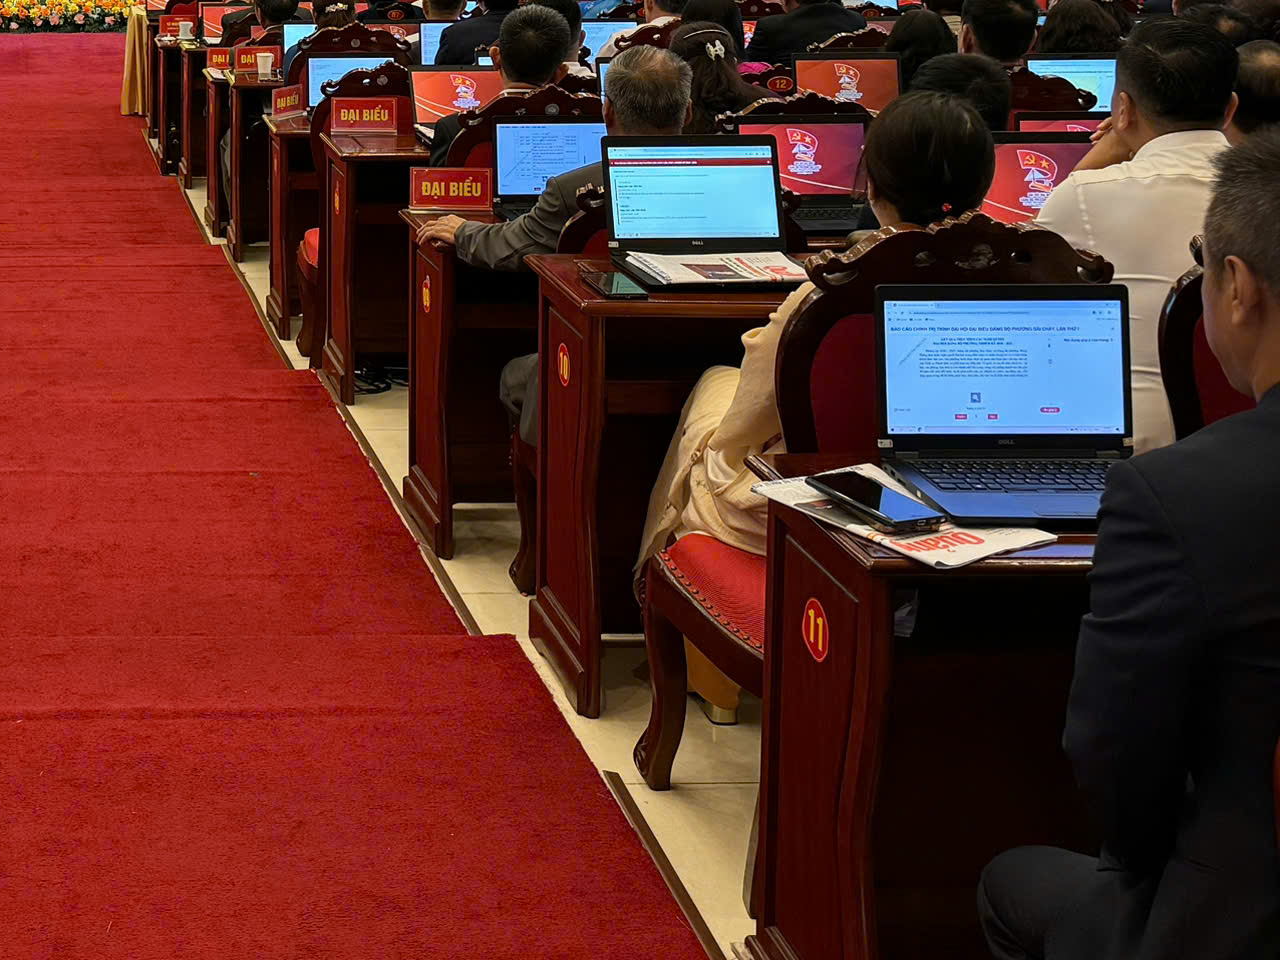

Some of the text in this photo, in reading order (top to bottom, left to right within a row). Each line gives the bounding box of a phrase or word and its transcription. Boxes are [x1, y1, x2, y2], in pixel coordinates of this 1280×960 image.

[241, 54, 254, 65] ĐẠI
[774, 79, 787, 89] 12
[276, 92, 299, 109] ĐẠI BIỂU
[340, 104, 389, 124] ĐẠI BIỂU
[421, 176, 481, 199] ĐẠI BIỂU
[809, 608, 824, 652] 11
